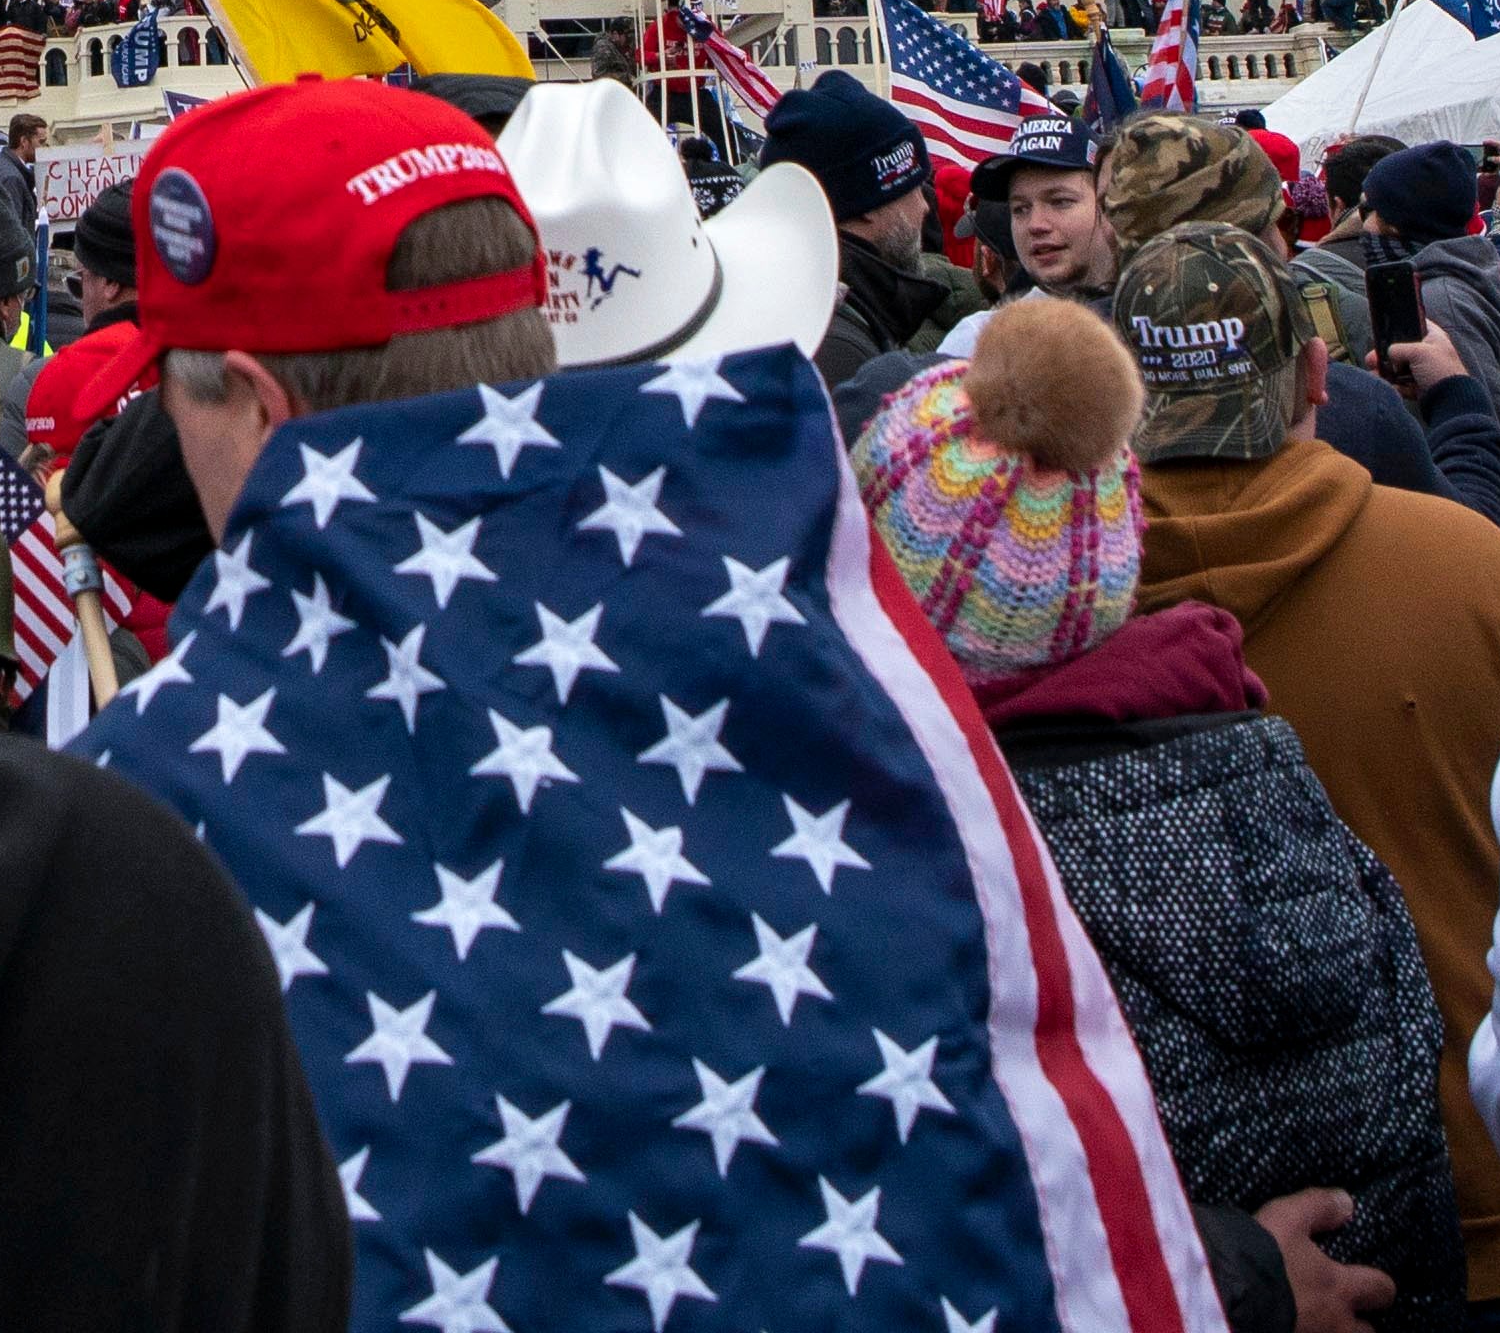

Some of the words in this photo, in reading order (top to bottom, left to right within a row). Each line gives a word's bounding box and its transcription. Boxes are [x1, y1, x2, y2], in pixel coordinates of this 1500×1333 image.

[134, 21, 150, 82] UMP
[871, 140, 916, 174] Trump
[1022, 136, 1062, 152] AGAIN
[1131, 315, 1245, 353] Trump
[1158, 371, 1190, 382] MORE
[1193, 367, 1224, 380] BULL
[1227, 361, 1252, 376] SHIT
[1171, 348, 1218, 369] 2020
